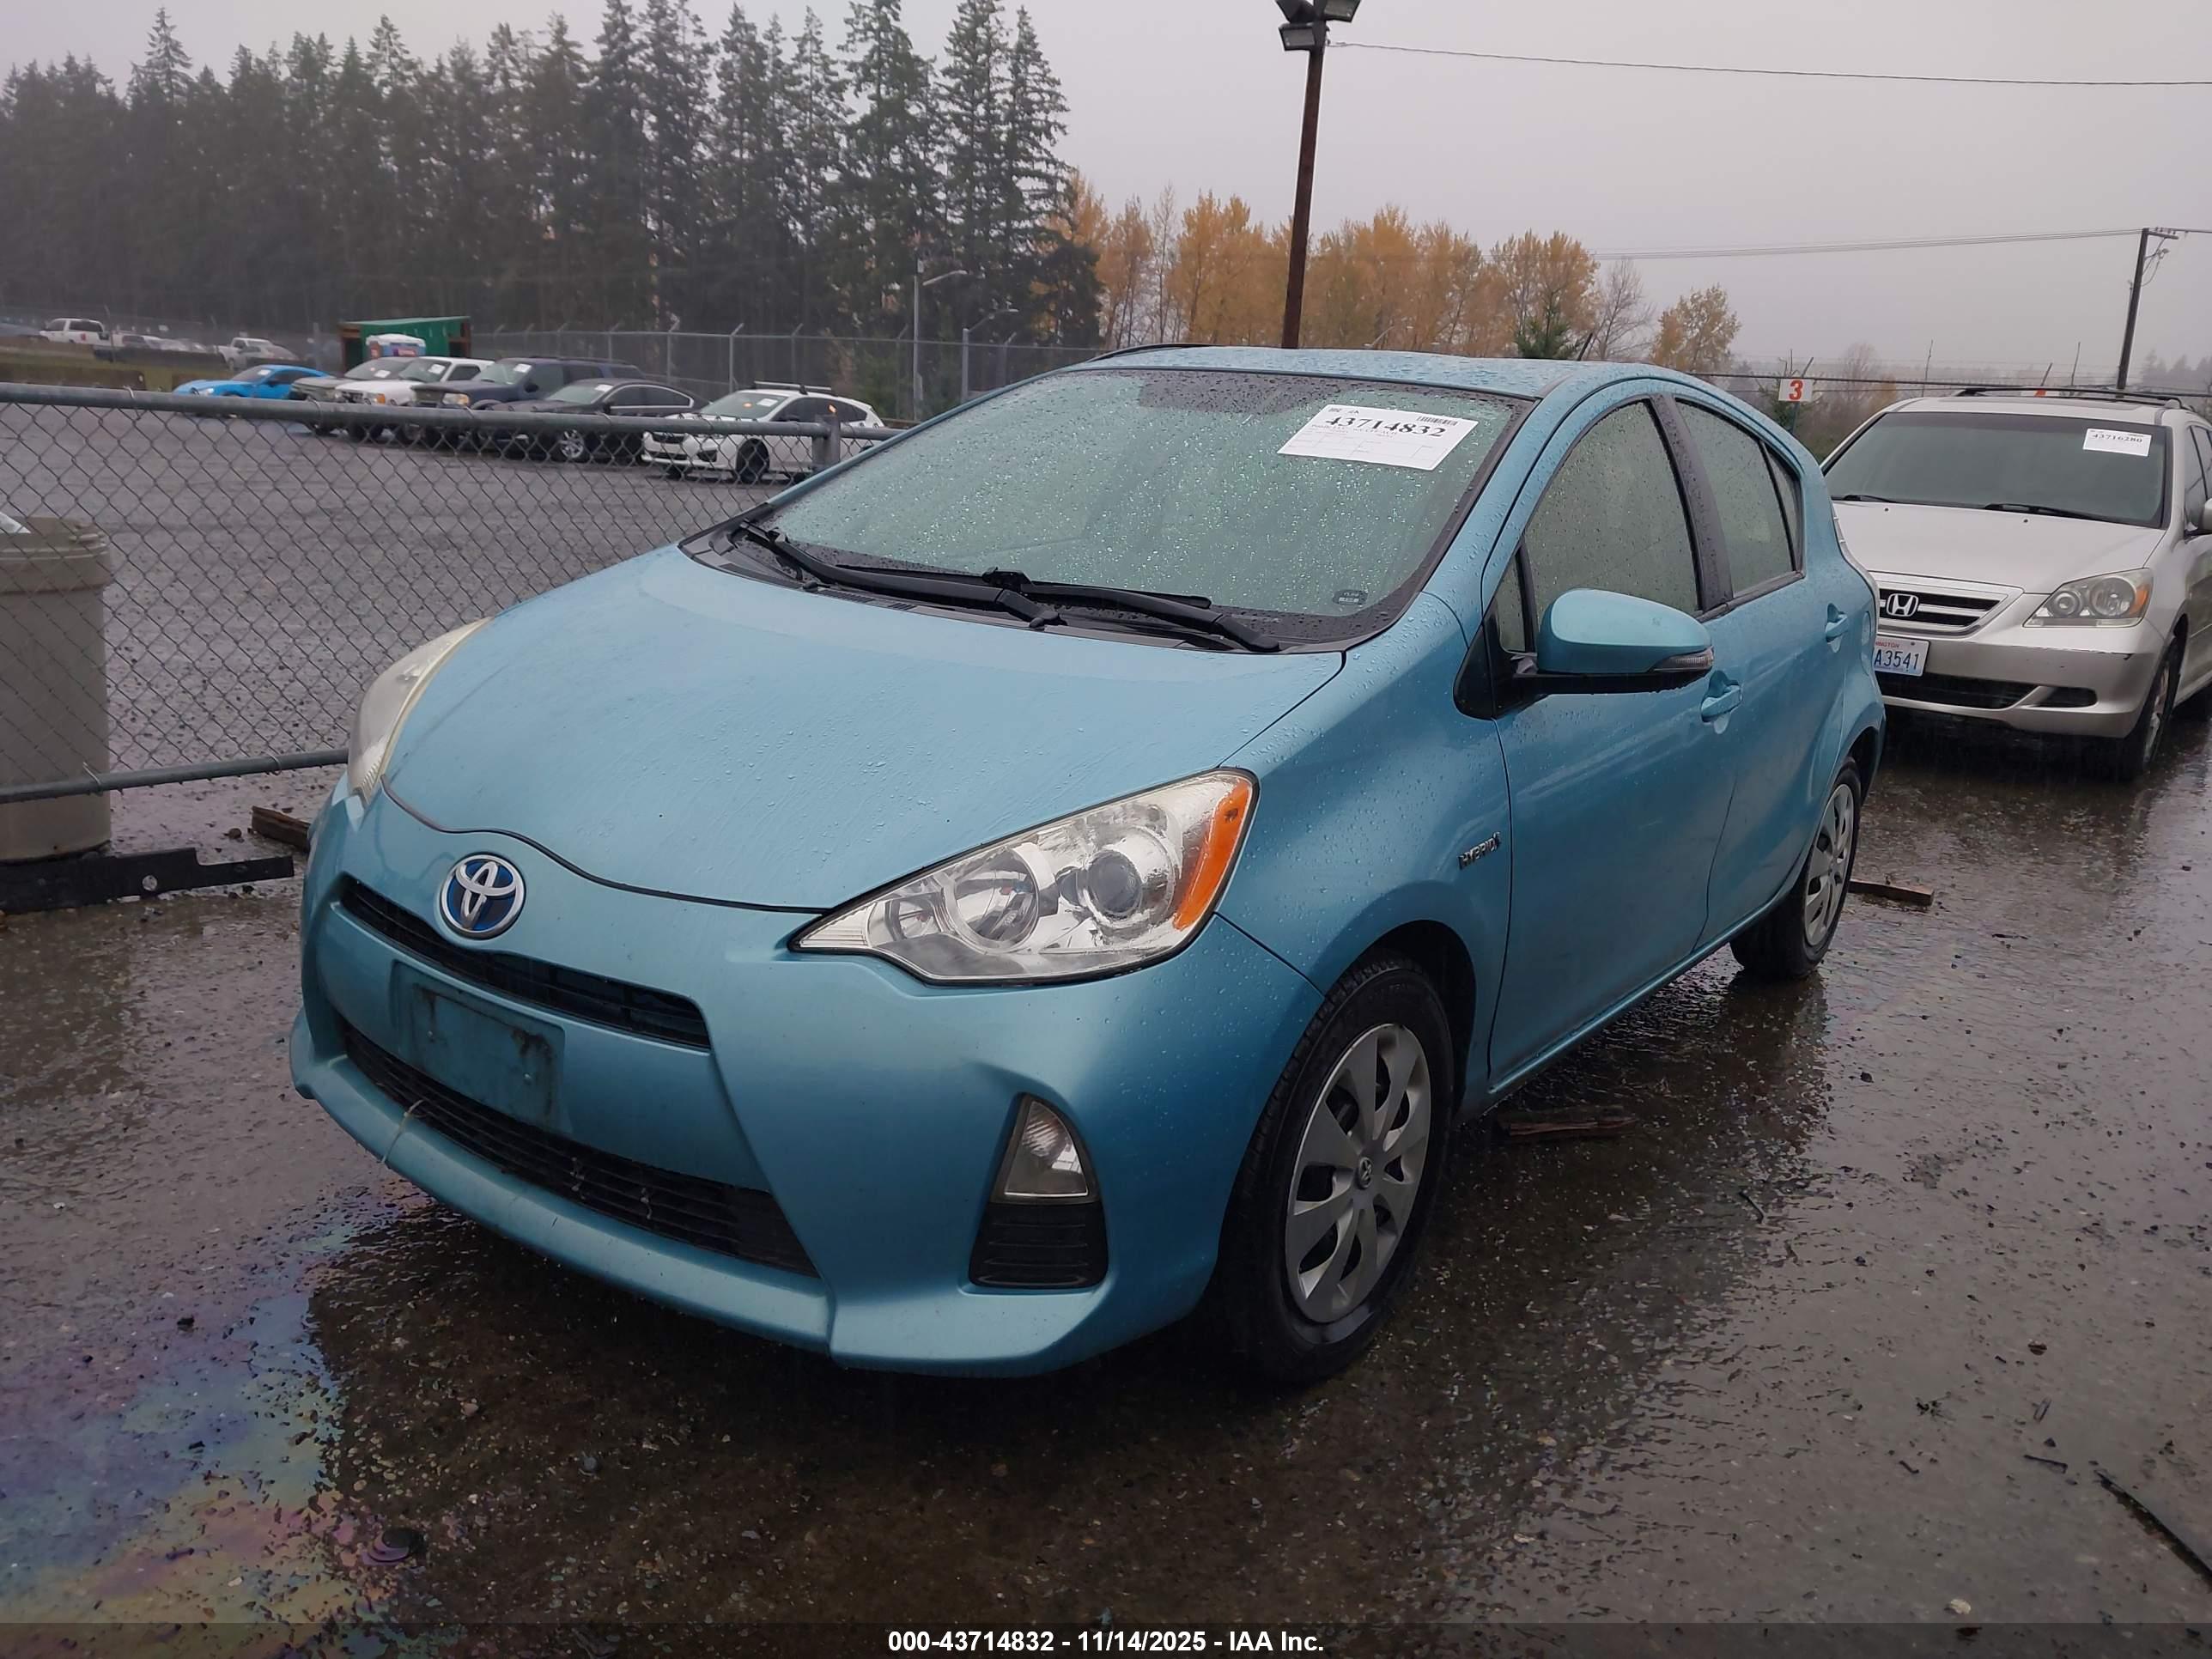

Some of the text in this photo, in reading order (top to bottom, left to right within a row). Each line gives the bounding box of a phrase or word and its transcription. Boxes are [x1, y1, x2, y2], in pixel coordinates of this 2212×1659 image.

[1789, 380, 1803, 400] 3
[1325, 416, 1446, 437] 43714832
[1875, 649, 1919, 670] A3541
